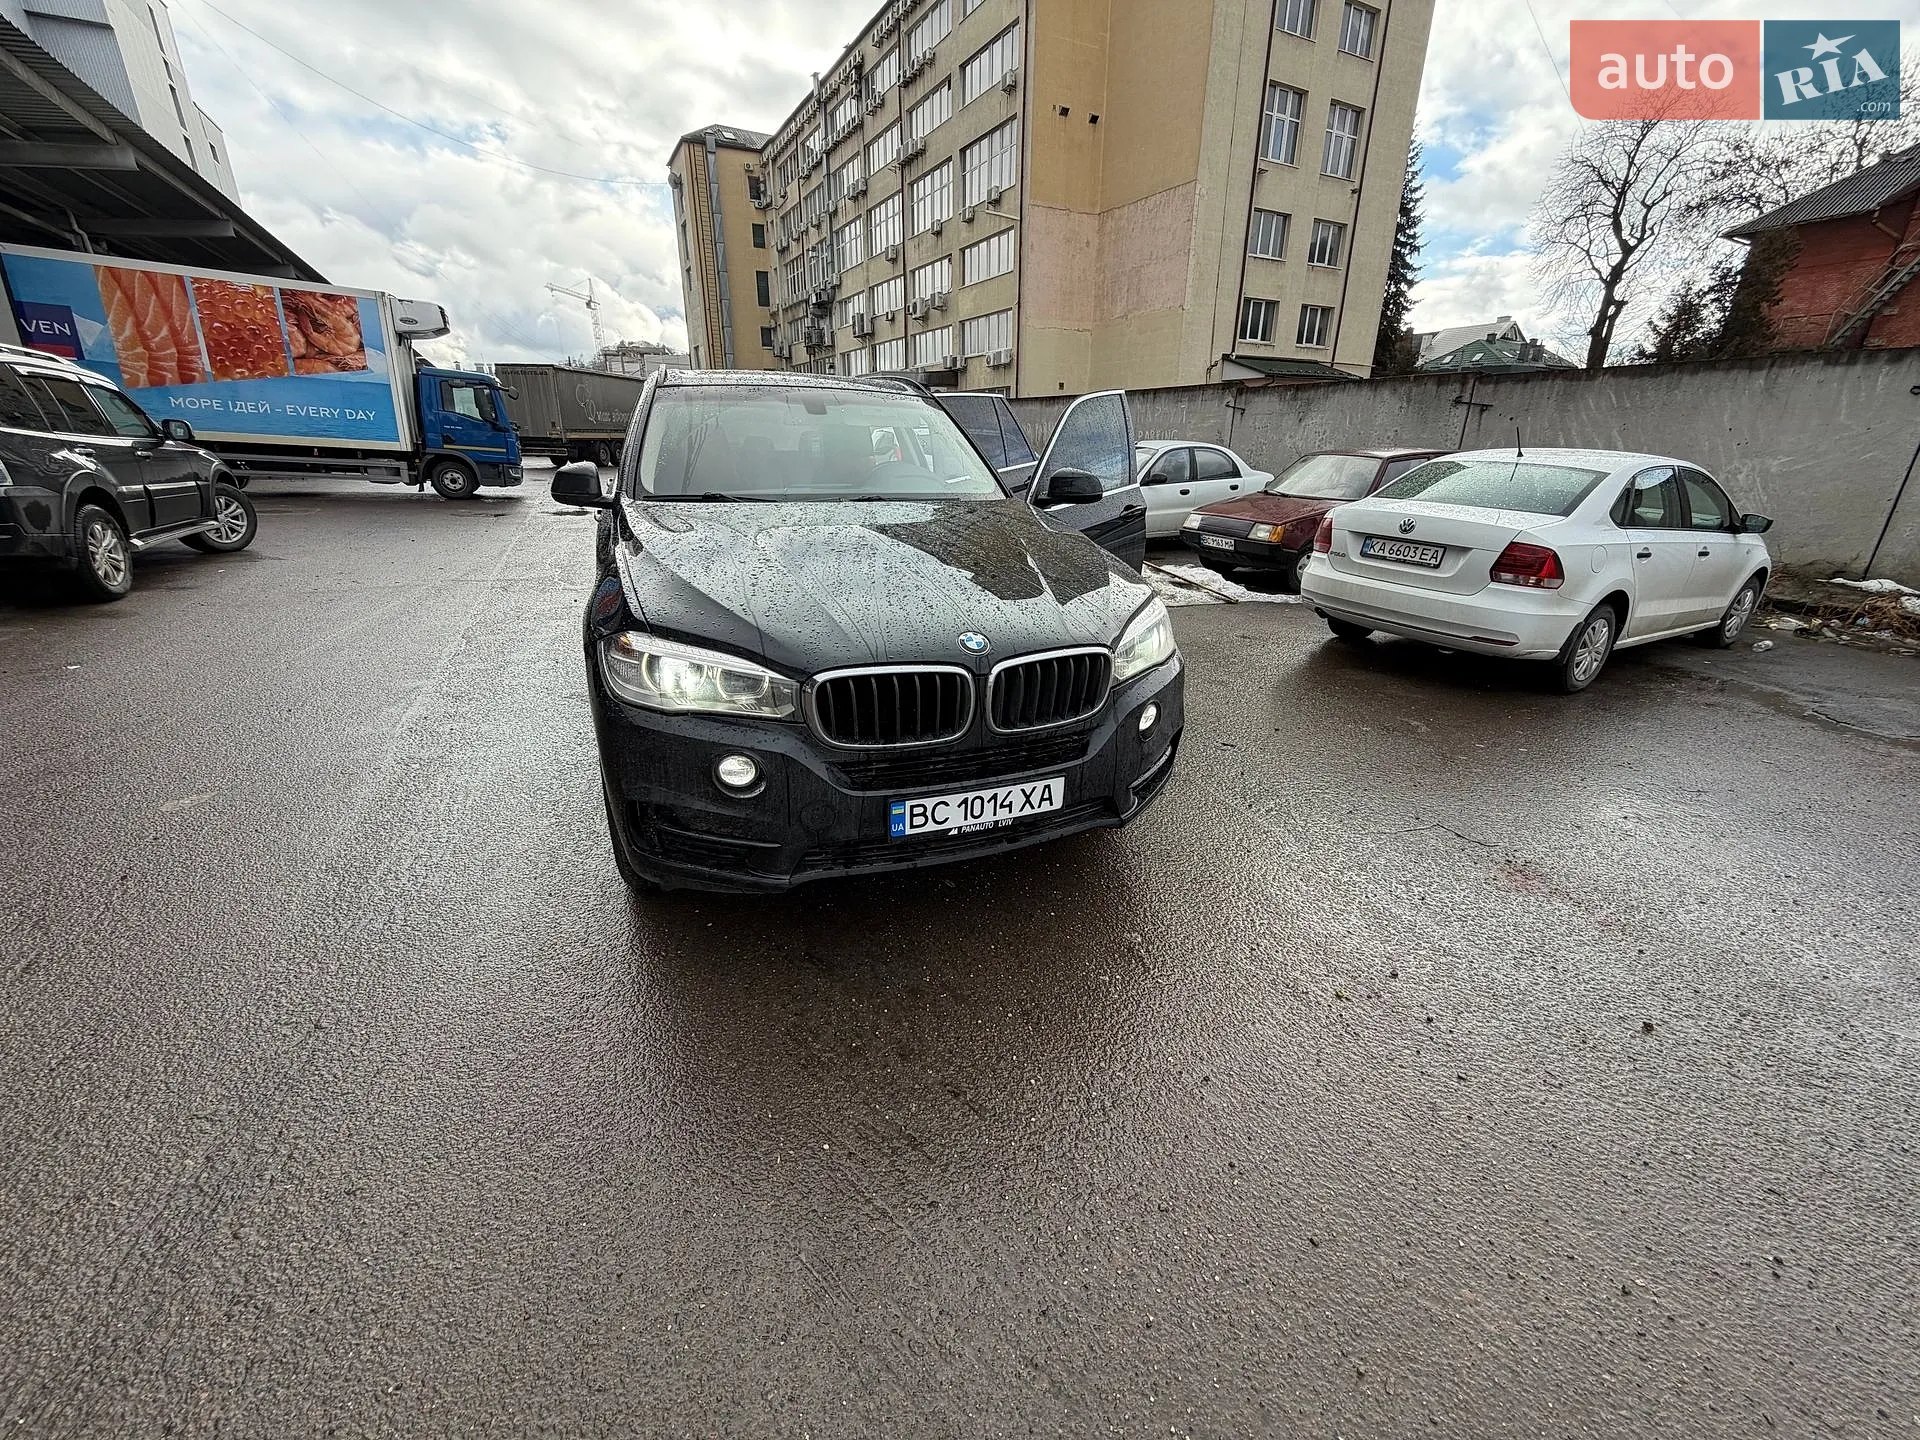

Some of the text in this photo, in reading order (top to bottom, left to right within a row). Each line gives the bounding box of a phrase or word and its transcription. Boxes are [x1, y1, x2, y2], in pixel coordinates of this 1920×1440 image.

[168, 396, 224, 411] МОРЕ
[228, 400, 271, 414] ІДЕЙ
[286, 405, 340, 419] EVERY
[344, 409, 376, 421] DAY
[1368, 541, 1440, 562] KA 6603 EA
[909, 784, 1054, 829] BC 1014 XA
[891, 823, 905, 832] UA
[961, 818, 1014, 833] PANAUTO LVIV
